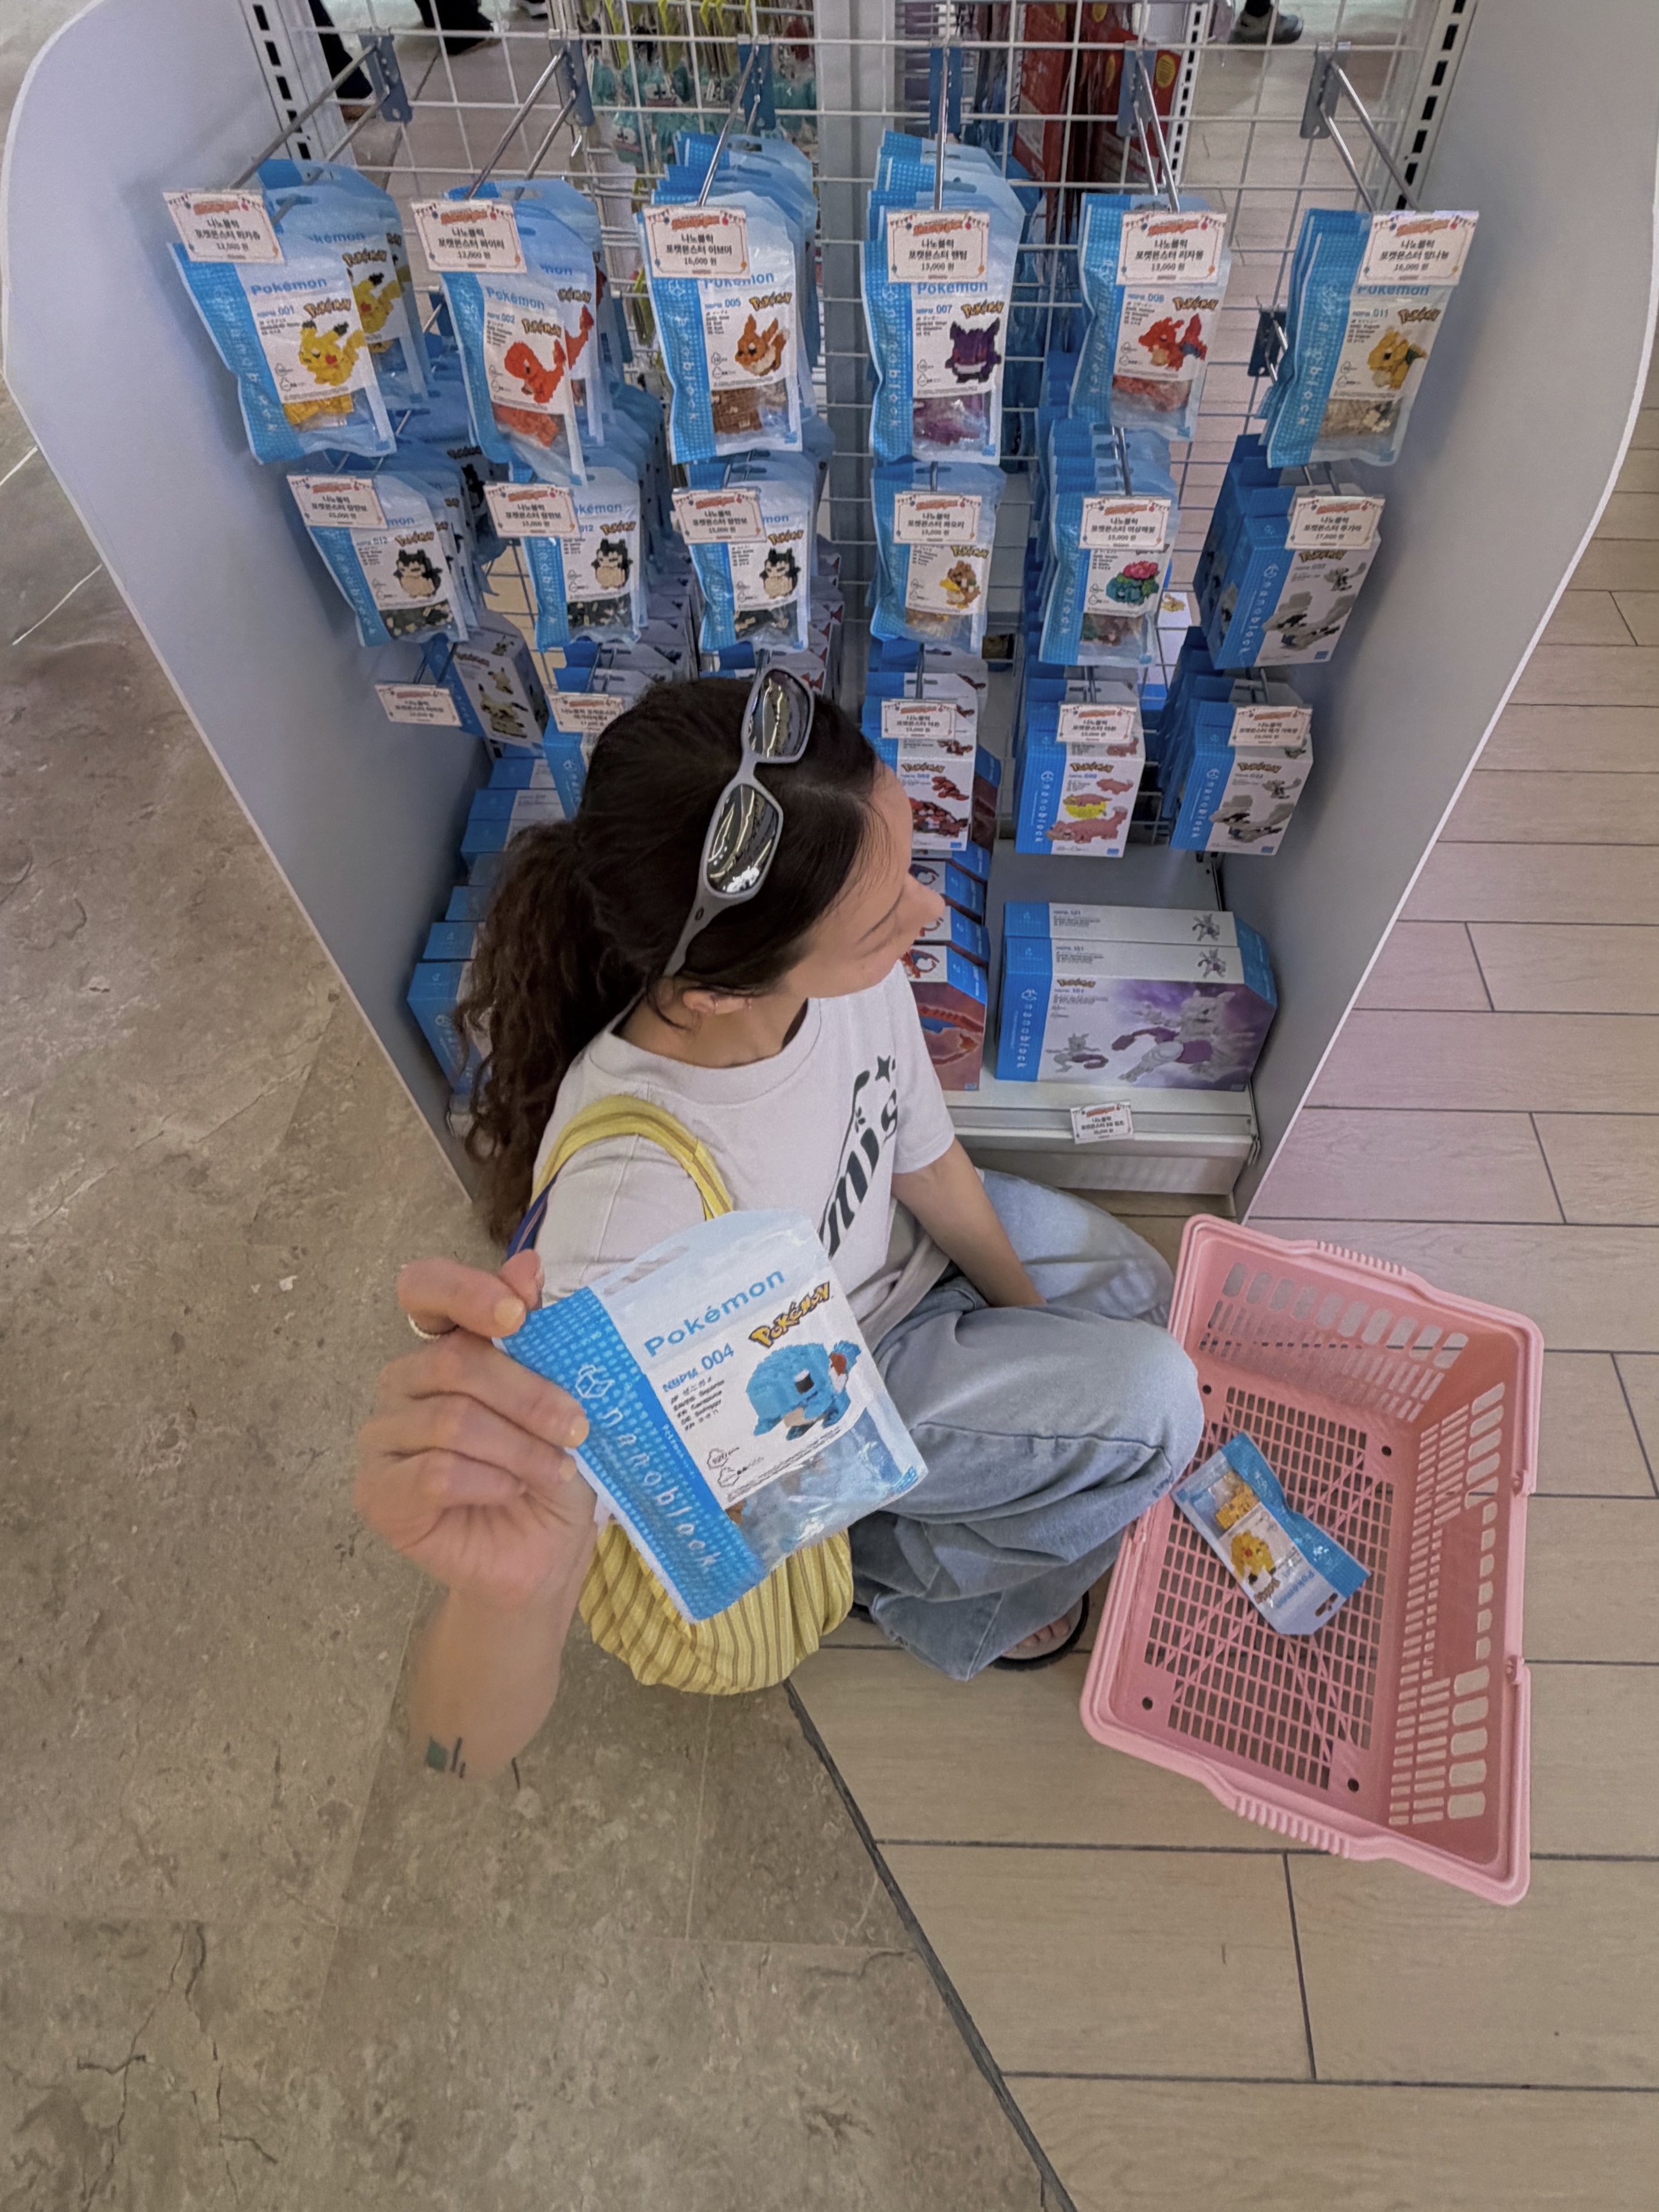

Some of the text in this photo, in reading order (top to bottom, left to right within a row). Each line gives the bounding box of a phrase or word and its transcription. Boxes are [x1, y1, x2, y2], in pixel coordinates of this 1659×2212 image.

[681, 234, 714, 244] 나노블럭
[921, 239, 954, 248] 나노블럭
[1154, 239, 1188, 249] 나노블럭
[1400, 239, 1435, 249] 나노블럭
[666, 245, 706, 255] 포켓몬스터
[909, 251, 949, 261] 포켓몬스터
[1135, 250, 1177, 261] 포켓몬스터
[1380, 251, 1422, 261] 포켓몬스터
[250, 278, 327, 296] Pokémon
[485, 286, 544, 310] Pokémon
[724, 298, 741, 308] 005
[278, 305, 295, 315] 001
[936, 305, 953, 314] 007
[1373, 309, 1389, 318] 011
[501, 313, 515, 324] 002
[575, 503, 622, 514] okémon
[644, 1270, 785, 1358] Pokémon
[748, 1281, 830, 1349] Pokémon
[701, 1343, 734, 1371] 004
[601, 1407, 721, 1567] nanoblock
